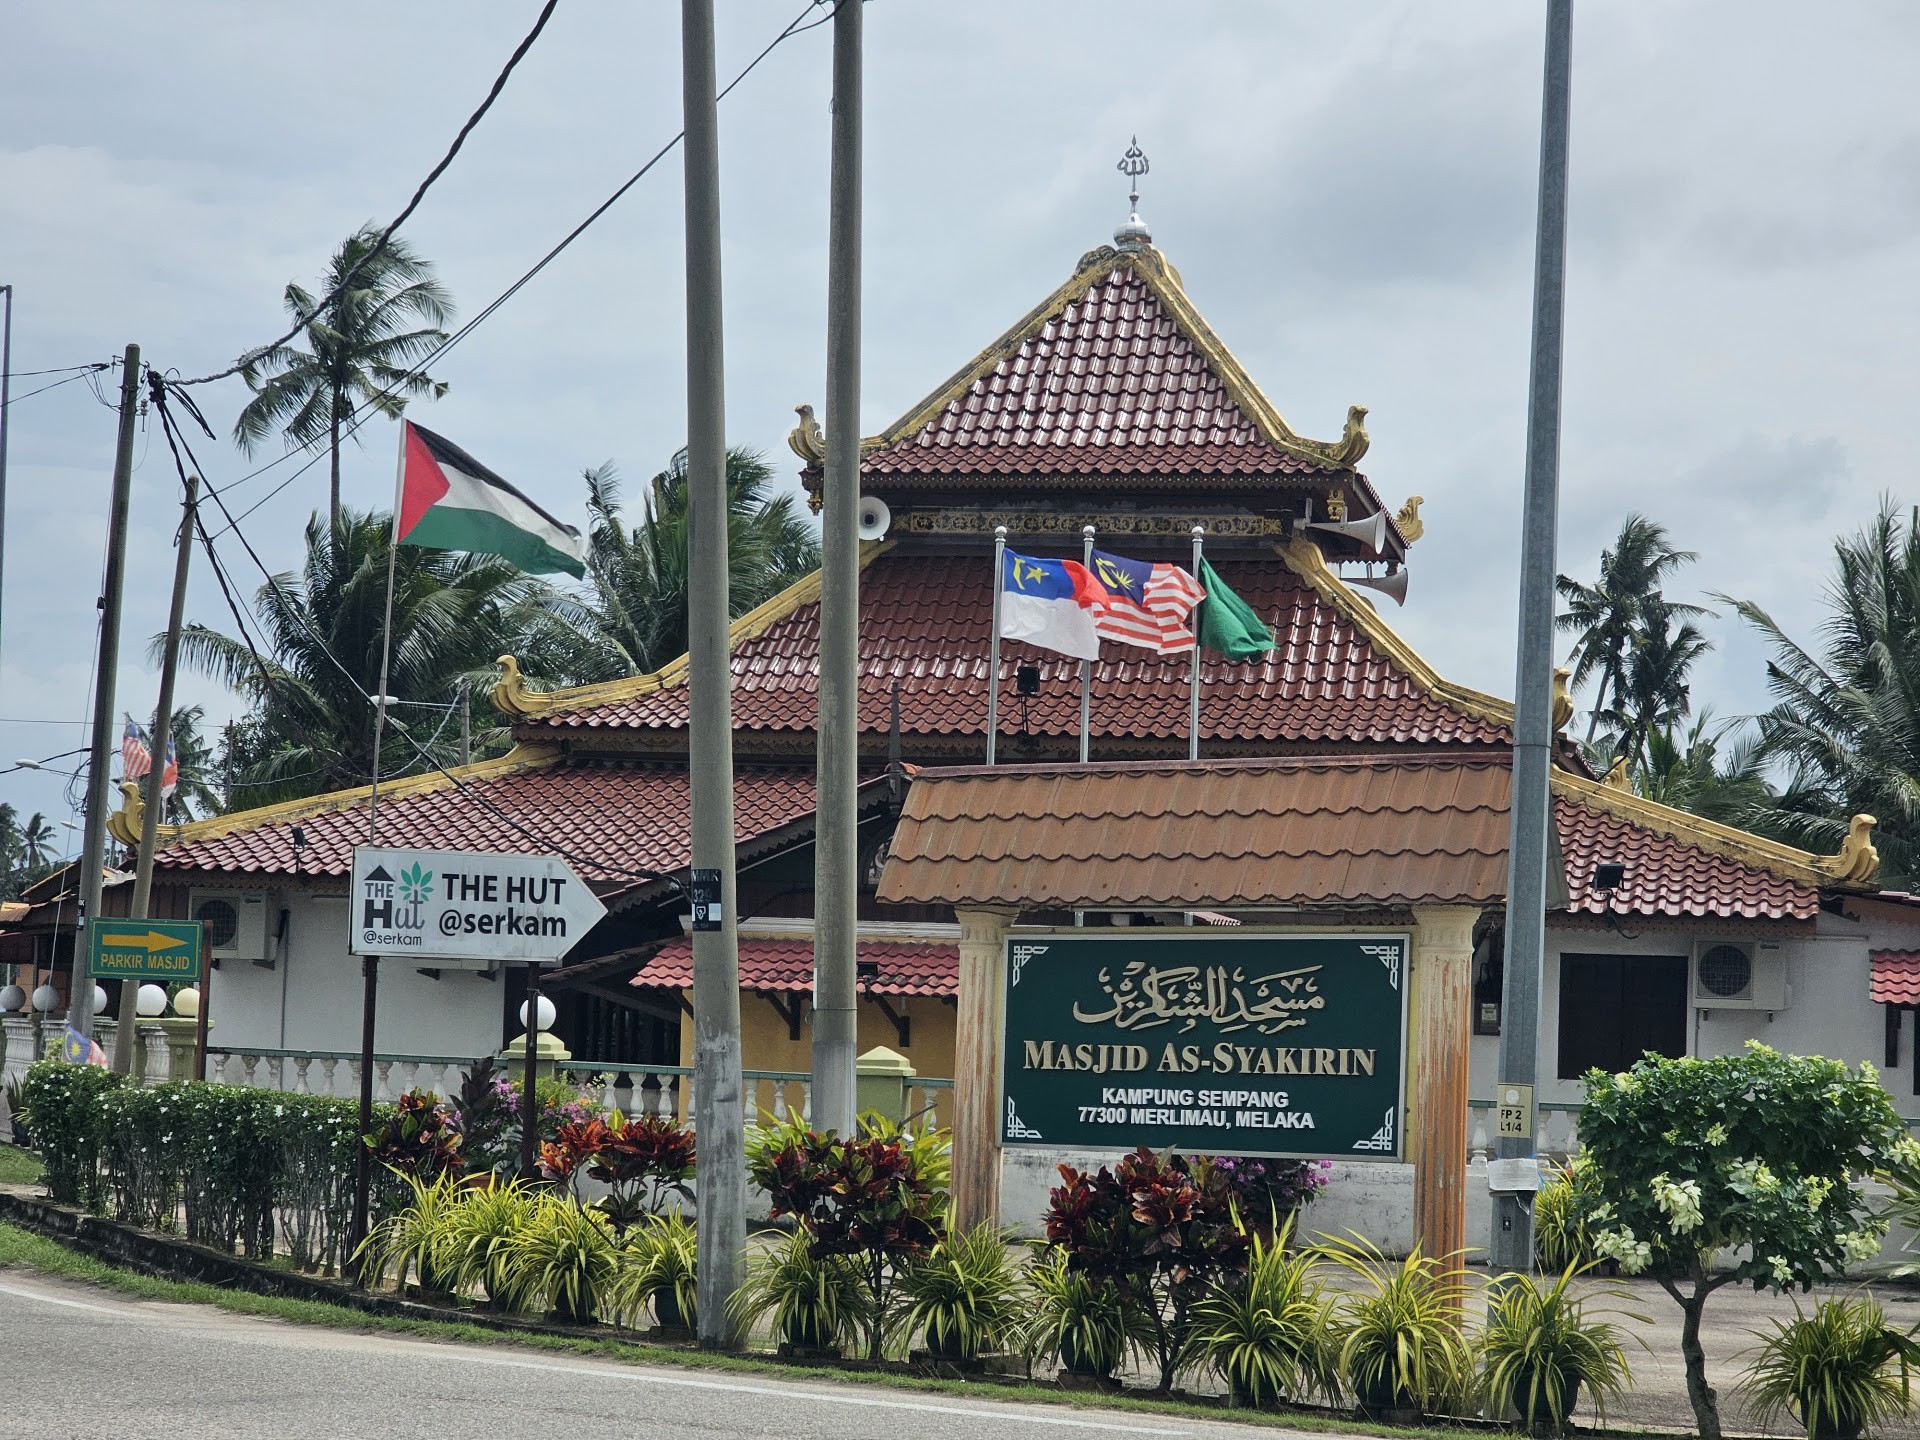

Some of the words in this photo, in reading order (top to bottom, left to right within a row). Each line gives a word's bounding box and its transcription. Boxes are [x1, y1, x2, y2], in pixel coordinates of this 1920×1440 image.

[364, 882, 394, 899] THE
[442, 873, 498, 902] THE
[506, 876, 567, 905] HUT
[363, 889, 425, 930] Hut
[439, 907, 567, 938] @serkam
[363, 930, 422, 946] @serkam
[100, 953, 143, 969] PARKIR
[147, 955, 190, 970] MASJID
[1211, 965, 1326, 1034] مسجد
[1102, 1087, 1195, 1107] KAMPUNG
[1198, 1089, 1289, 1108] SEMPANG
[1078, 1106, 1126, 1124] 77300
[1130, 1108, 1232, 1130] MERLIMAU,
[1235, 1111, 1315, 1129] MELAKA
[1500, 1109, 1513, 1119] FP
[1515, 1110, 1522, 1120] 2
[1500, 1121, 1522, 1132] L1/4
